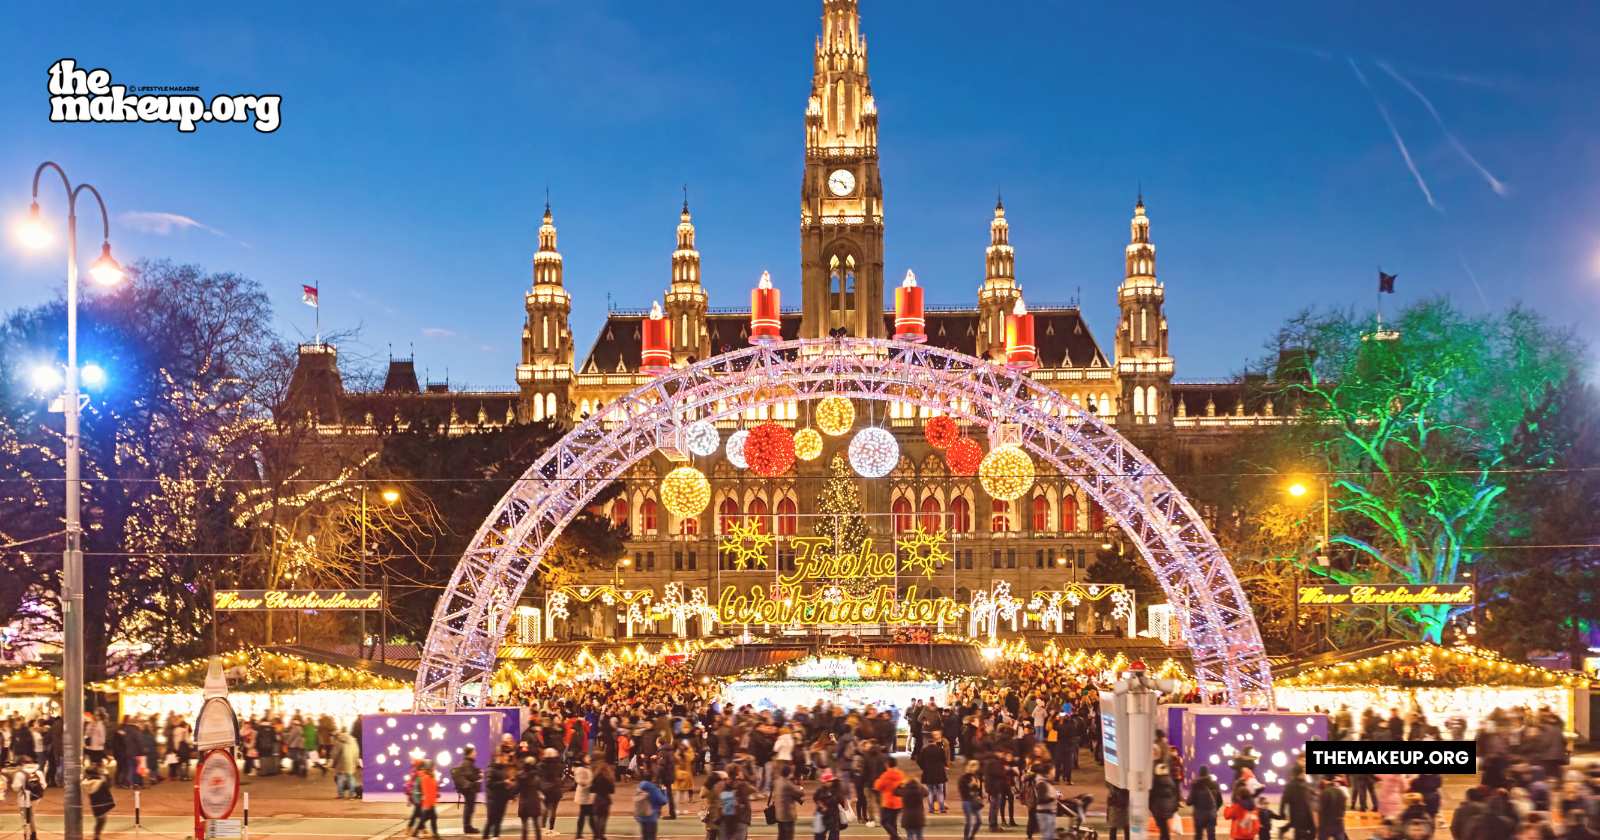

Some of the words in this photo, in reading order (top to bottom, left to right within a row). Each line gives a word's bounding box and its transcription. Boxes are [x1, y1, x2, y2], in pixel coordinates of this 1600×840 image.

[779, 537, 897, 585] Frohe
[215, 591, 262, 609] Wiener
[264, 591, 382, 609] Christkindlmarkt
[718, 584, 957, 625] Weihnachten
[1298, 586, 1349, 604] Wiener
[1350, 586, 1474, 604] Christkindlmarkt
